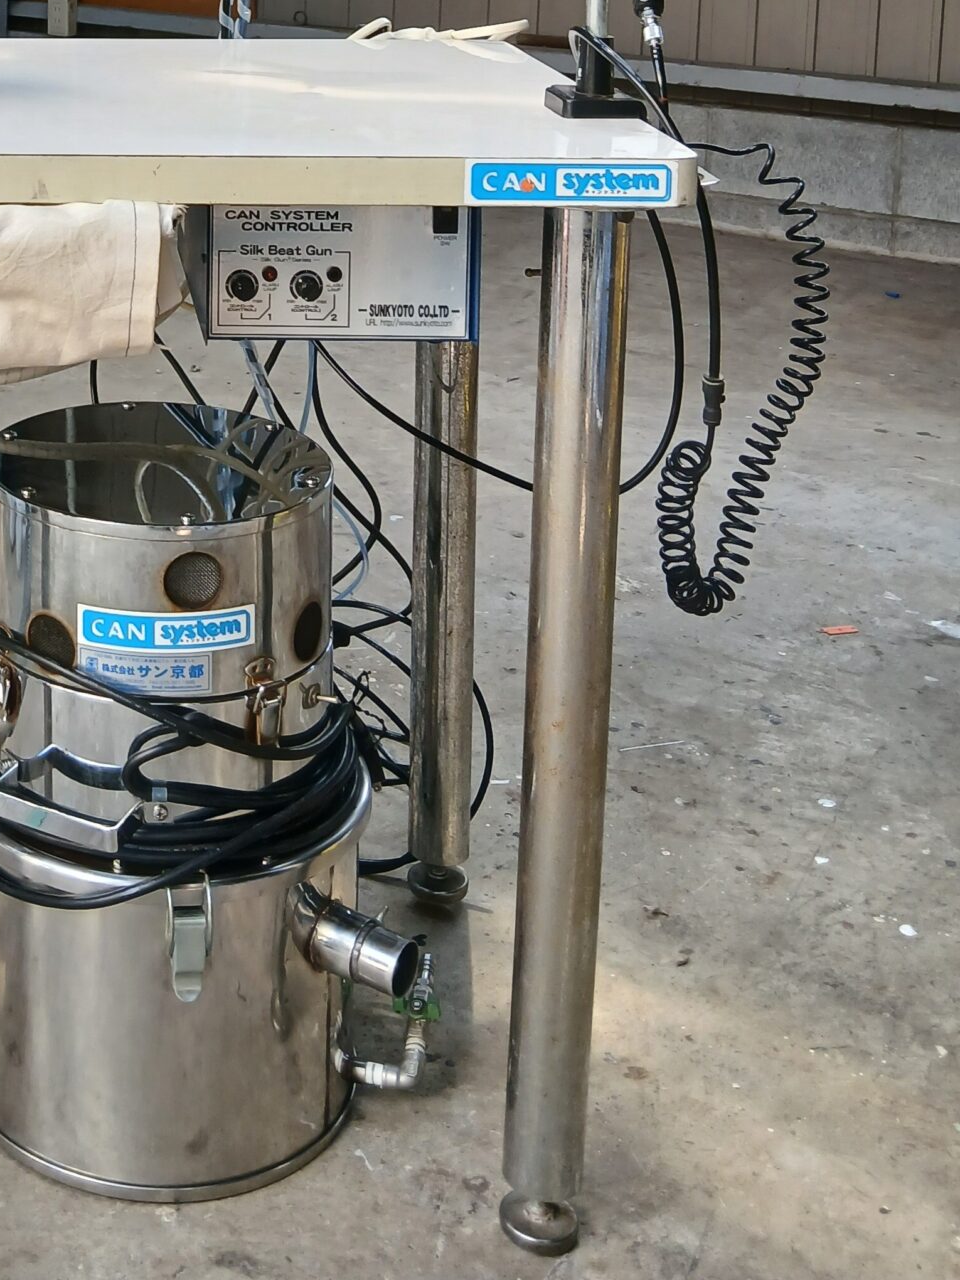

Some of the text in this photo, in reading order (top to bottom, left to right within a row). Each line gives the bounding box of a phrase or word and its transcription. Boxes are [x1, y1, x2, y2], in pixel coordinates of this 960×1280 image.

[482, 169, 660, 196] CAN system
[224, 210, 339, 221] CAN SYSTEM
[241, 222, 353, 232] CONTROLLER
[239, 244, 333, 256] Silk Beat Gun
[330, 313, 338, 321] 2
[369, 304, 414, 318] SUNKYOTO
[91, 619, 241, 645] CAN system
[102, 663, 204, 679] 株式会社サン京都
